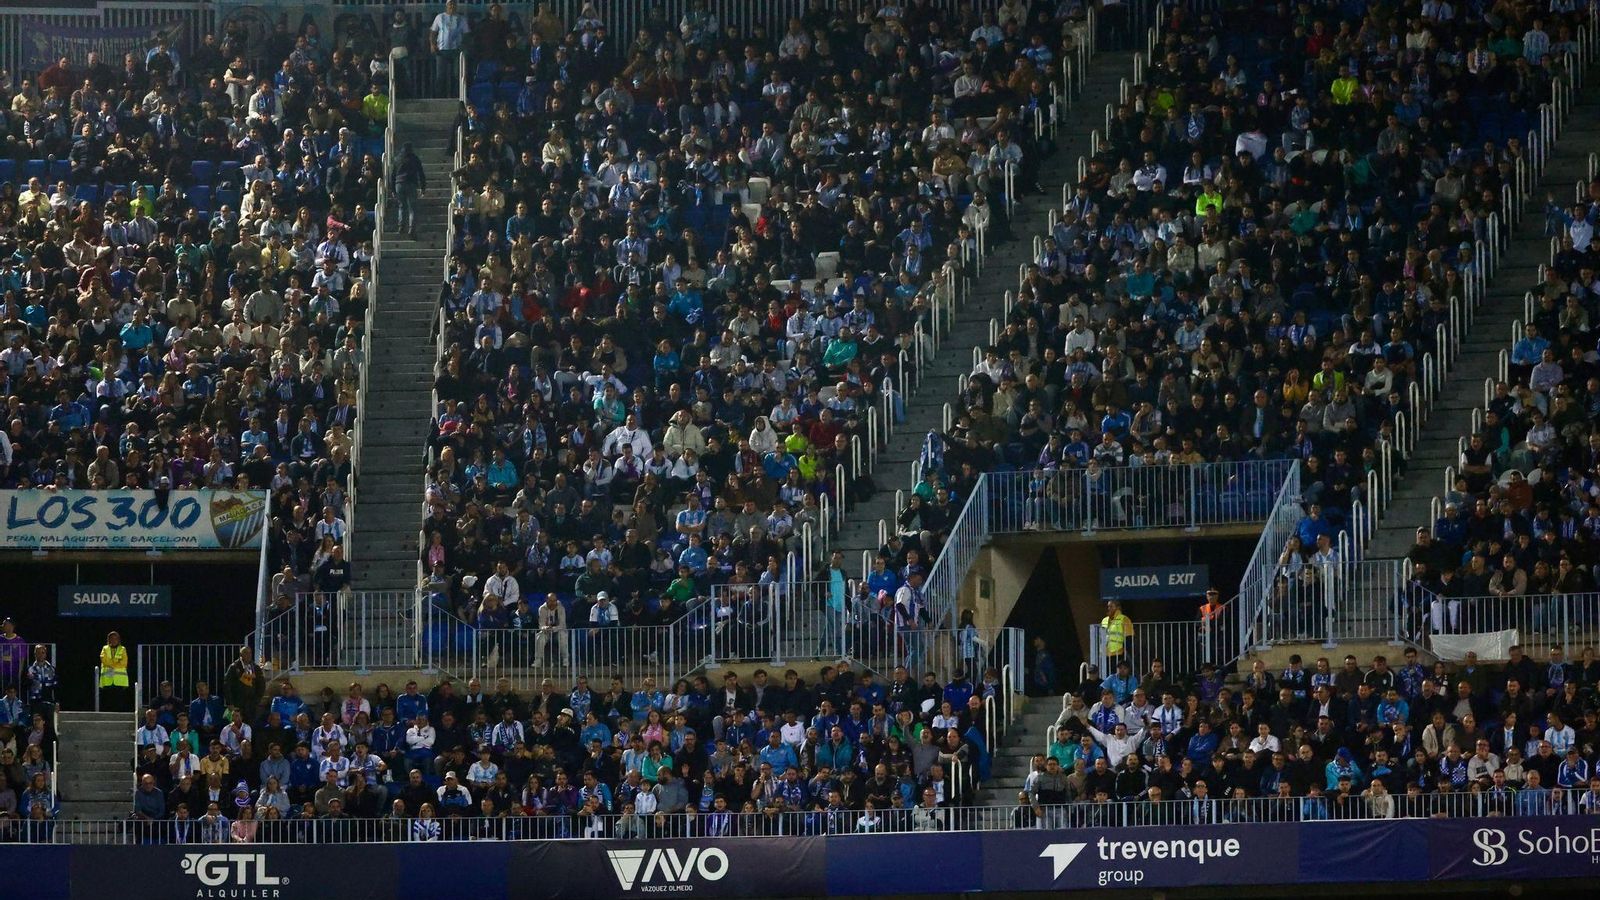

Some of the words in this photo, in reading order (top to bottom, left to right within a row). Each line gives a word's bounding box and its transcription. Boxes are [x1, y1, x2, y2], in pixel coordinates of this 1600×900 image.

[7, 496, 98, 530] LOS
[105, 496, 201, 530] 300
[130, 535, 198, 543] BARCELONA
[1114, 574, 1160, 588] SALIDA
[1168, 573, 1196, 585] EXIT
[73, 593, 120, 604] SALIDA
[129, 593, 158, 604] EXIT
[1097, 836, 1240, 864] trevenque
[1098, 869, 1144, 886] group
[196, 889, 280, 898] ALQUILER
[668, 884, 693, 892] OLMEDO
